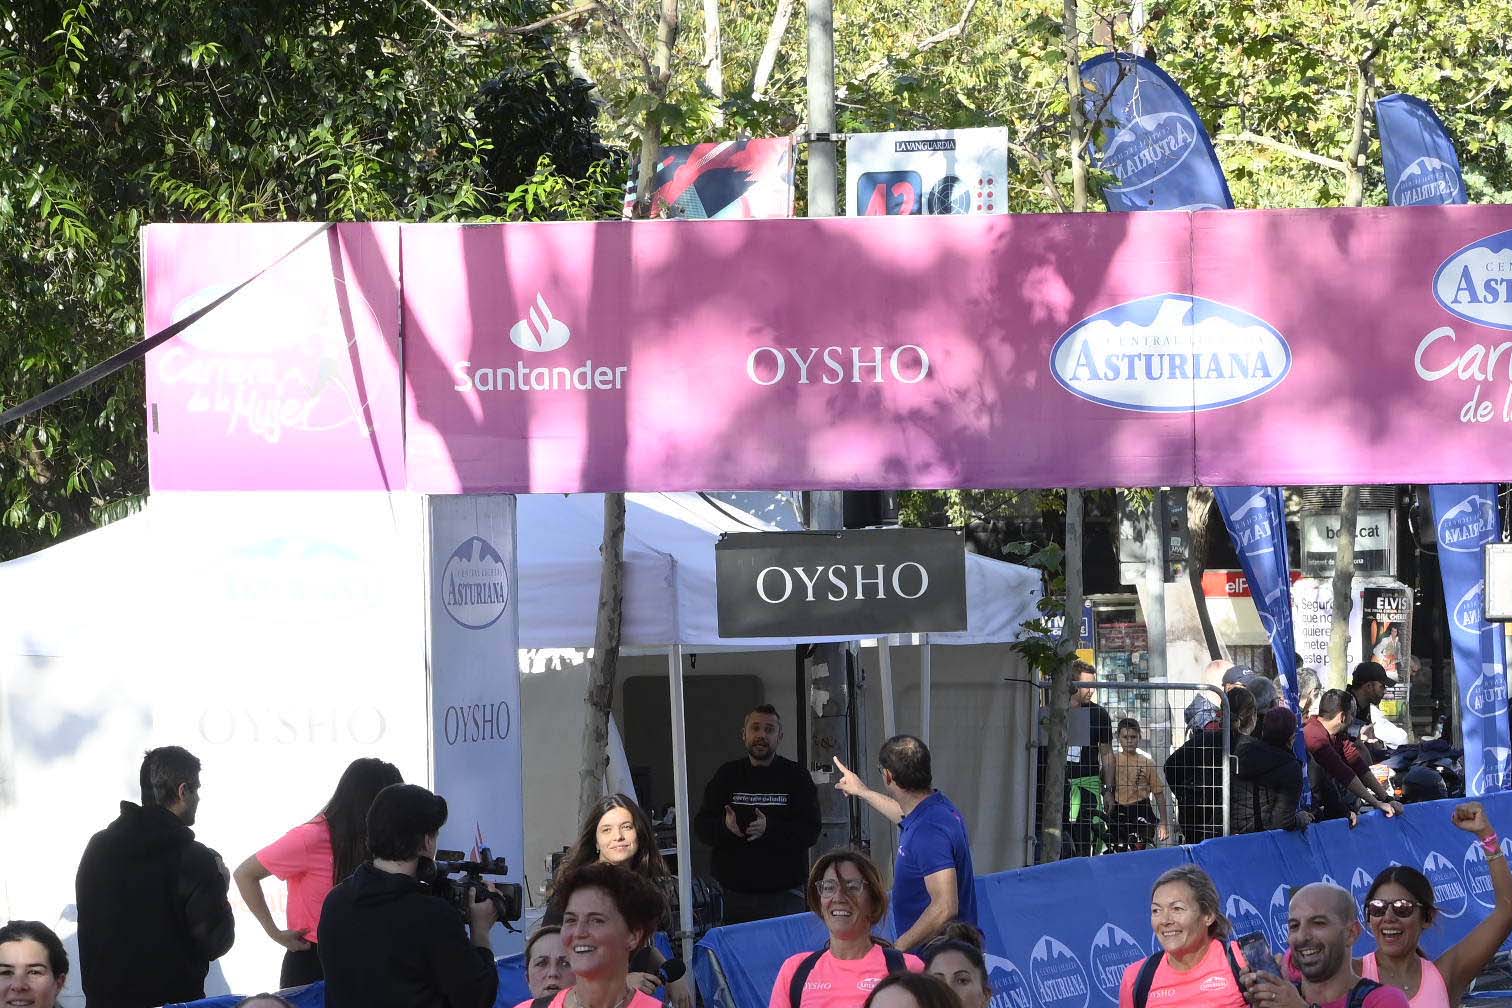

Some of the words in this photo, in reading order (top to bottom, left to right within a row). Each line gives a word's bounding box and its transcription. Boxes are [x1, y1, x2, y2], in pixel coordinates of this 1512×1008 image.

[454, 361, 627, 393] Santander
[746, 344, 931, 386] OYSHO
[1069, 332, 1274, 382] ASTURIANA
[1460, 385, 1494, 424] de
[447, 576, 505, 607] ASTURIANA
[756, 561, 929, 604] OYSHO
[1376, 597, 1407, 609] ELVIS
[197, 704, 388, 747] OYSHO
[444, 701, 511, 747] OYSHO
[1037, 972, 1088, 1004] ASTURIANA
